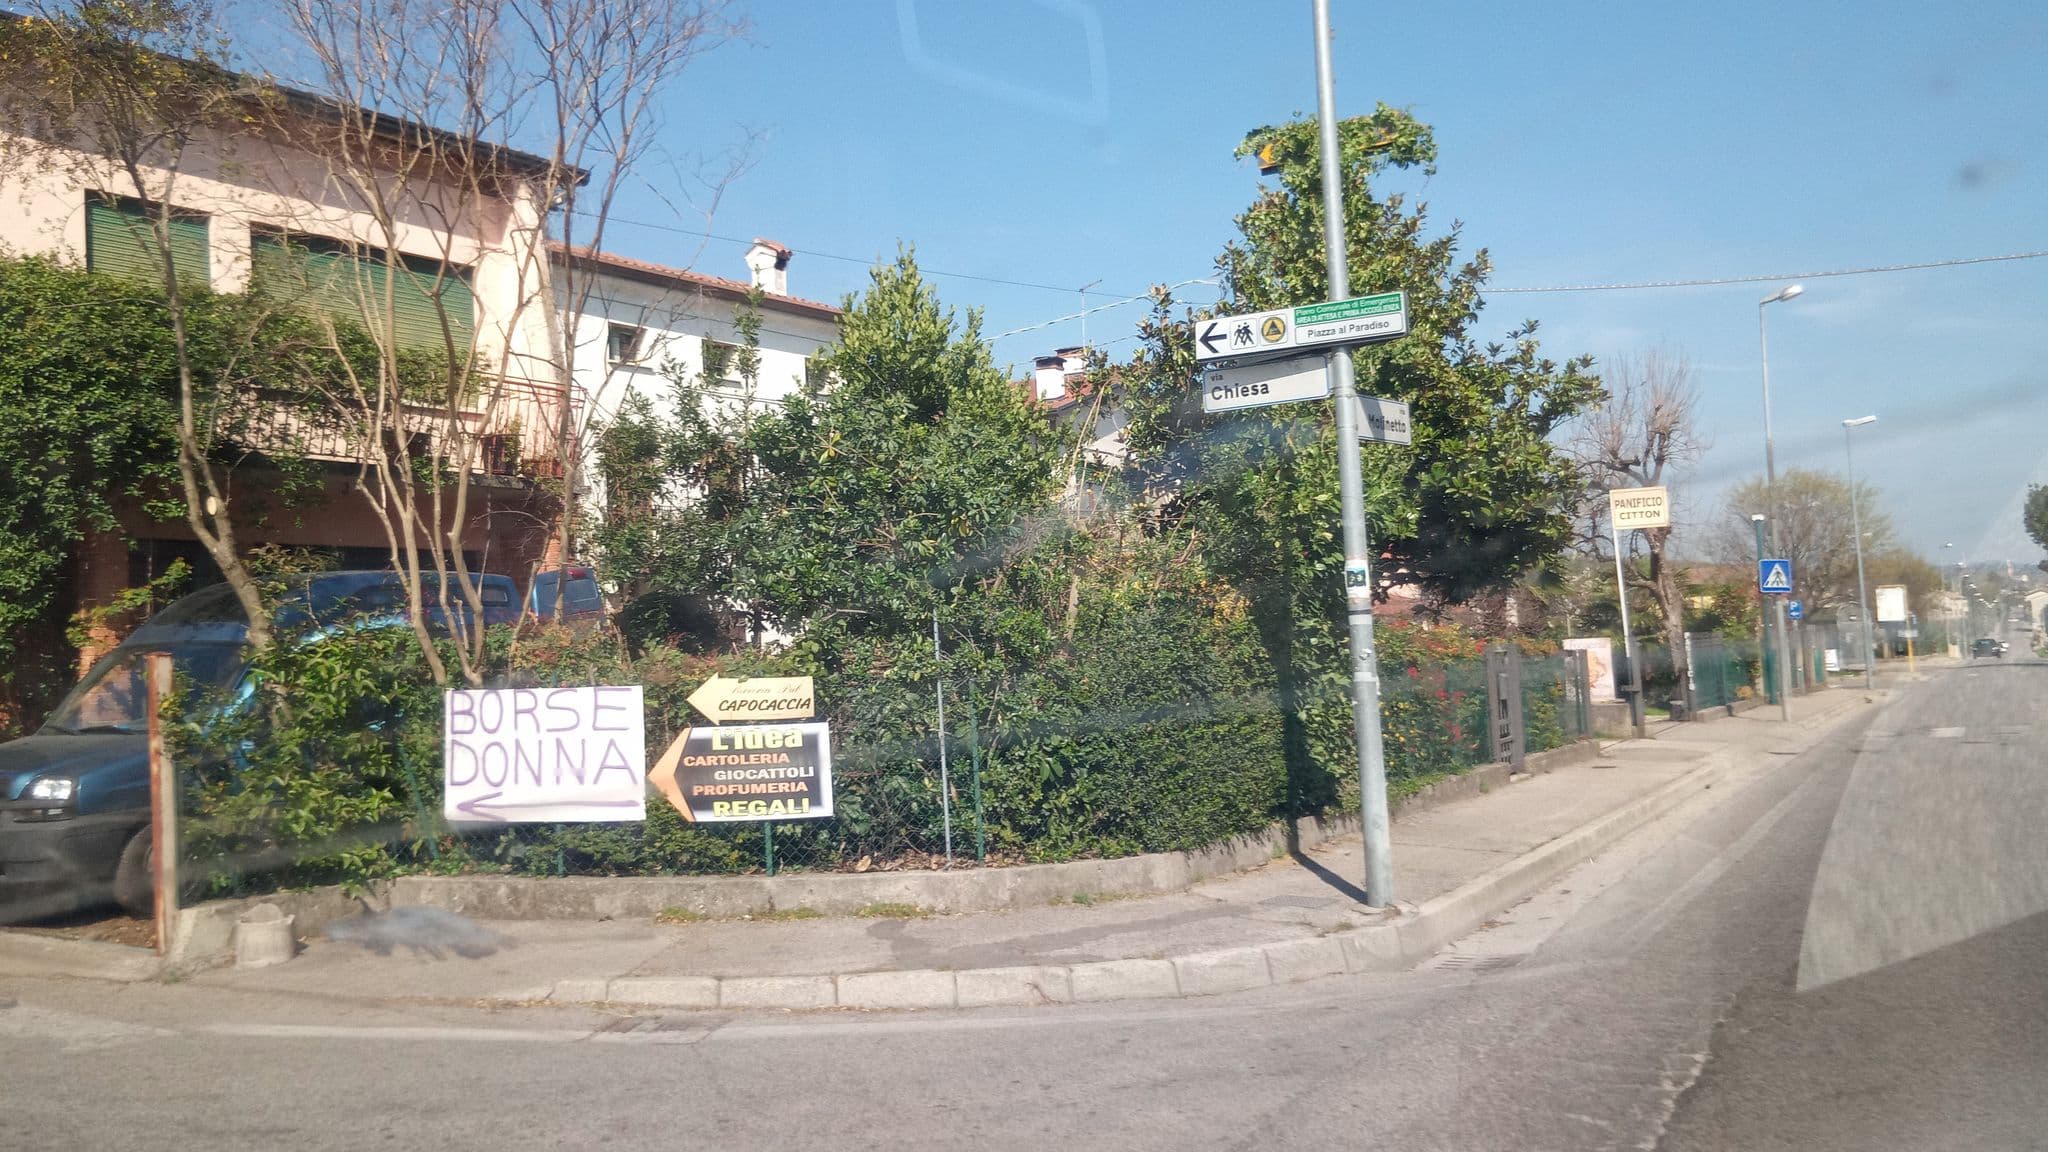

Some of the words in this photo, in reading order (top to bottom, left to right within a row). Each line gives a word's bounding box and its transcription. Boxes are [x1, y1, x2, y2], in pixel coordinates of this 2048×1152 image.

[1316, 303, 1351, 314] Comunale
[1360, 297, 1399, 307] Emergenza
[1307, 328, 1336, 338] Piazza
[1338, 325, 1347, 334] al
[1349, 320, 1390, 333] Paradiso
[1210, 373, 1223, 381] via
[1211, 382, 1270, 401] Chiesa
[1368, 413, 1406, 433] Molinetto
[1614, 496, 1663, 508] PANIFICIO
[1619, 510, 1661, 520] CITTON
[450, 686, 633, 735] BORSE
[718, 698, 812, 712] CAPOCACCIA
[711, 727, 804, 751] L'idea
[449, 737, 639, 787] DONNA
[683, 752, 791, 767] CARTOLERIA
[713, 766, 815, 781] GIOCATTOLI
[692, 781, 809, 797] PROFUMERIA
[712, 797, 811, 818] REGALI
